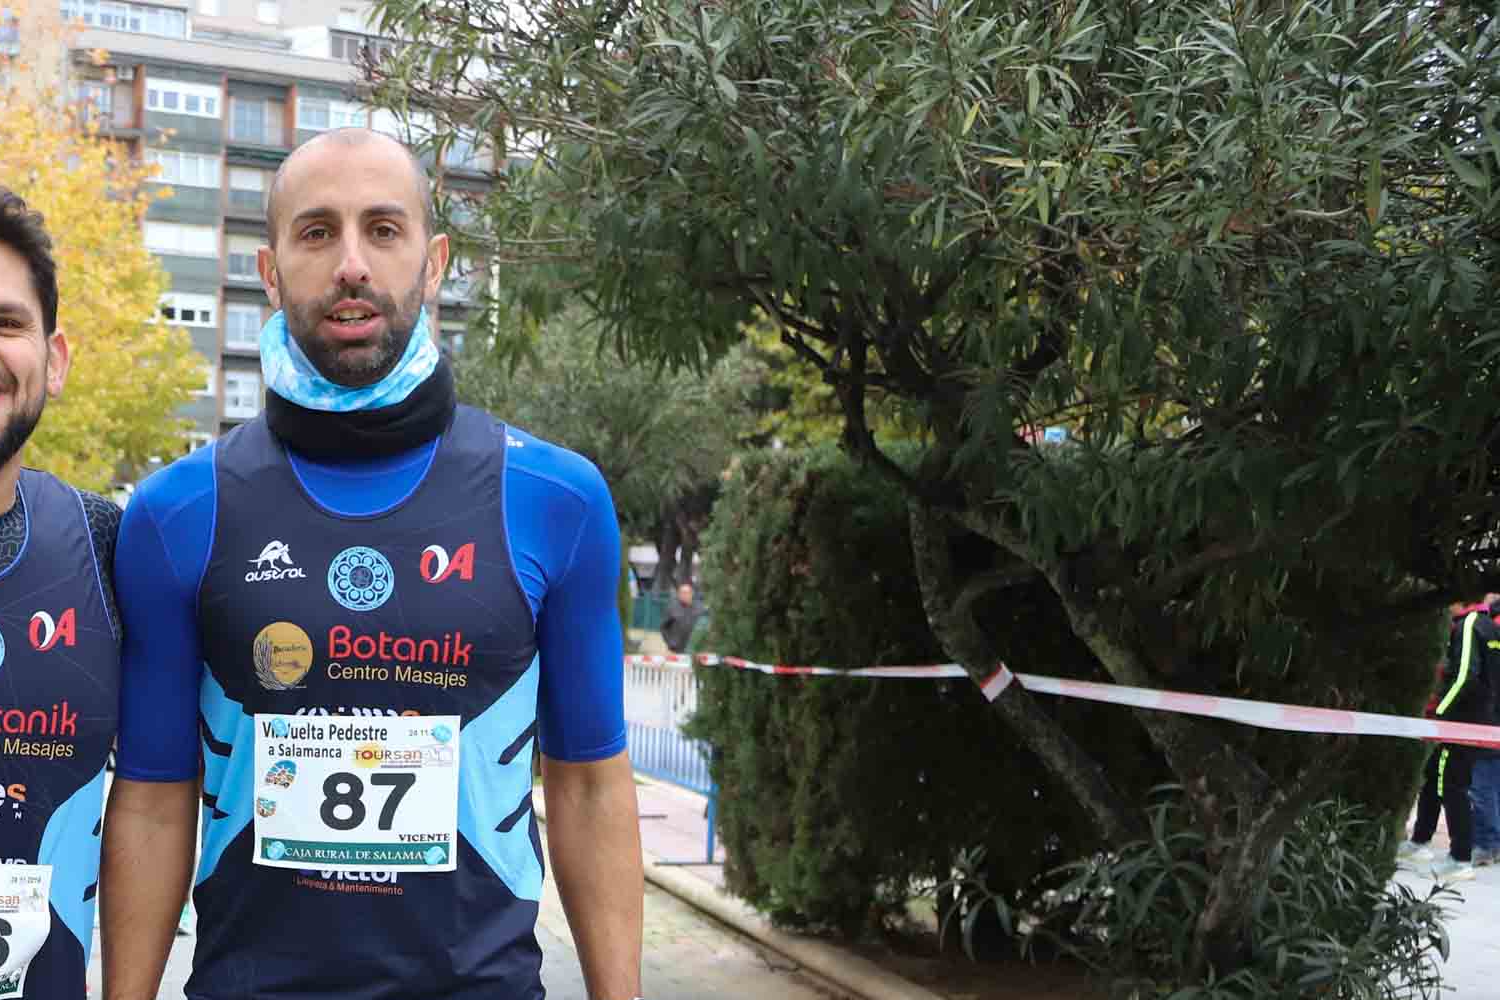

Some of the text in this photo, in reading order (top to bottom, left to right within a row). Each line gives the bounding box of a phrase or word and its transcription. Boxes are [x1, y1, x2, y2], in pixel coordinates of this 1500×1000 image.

[328, 624, 474, 667] Botanik
[327, 662, 389, 681] Centro
[394, 665, 468, 688] Masajes
[328, 723, 388, 742] Pedestre
[3, 737, 75, 761] Masajes
[268, 743, 343, 759] a Salamanca
[319, 771, 417, 831] 87
[398, 832, 451, 843] VICENTE
[315, 848, 352, 860] RURAL
[355, 849, 371, 860] DE
[336, 881, 404, 896] Mantenimiento
